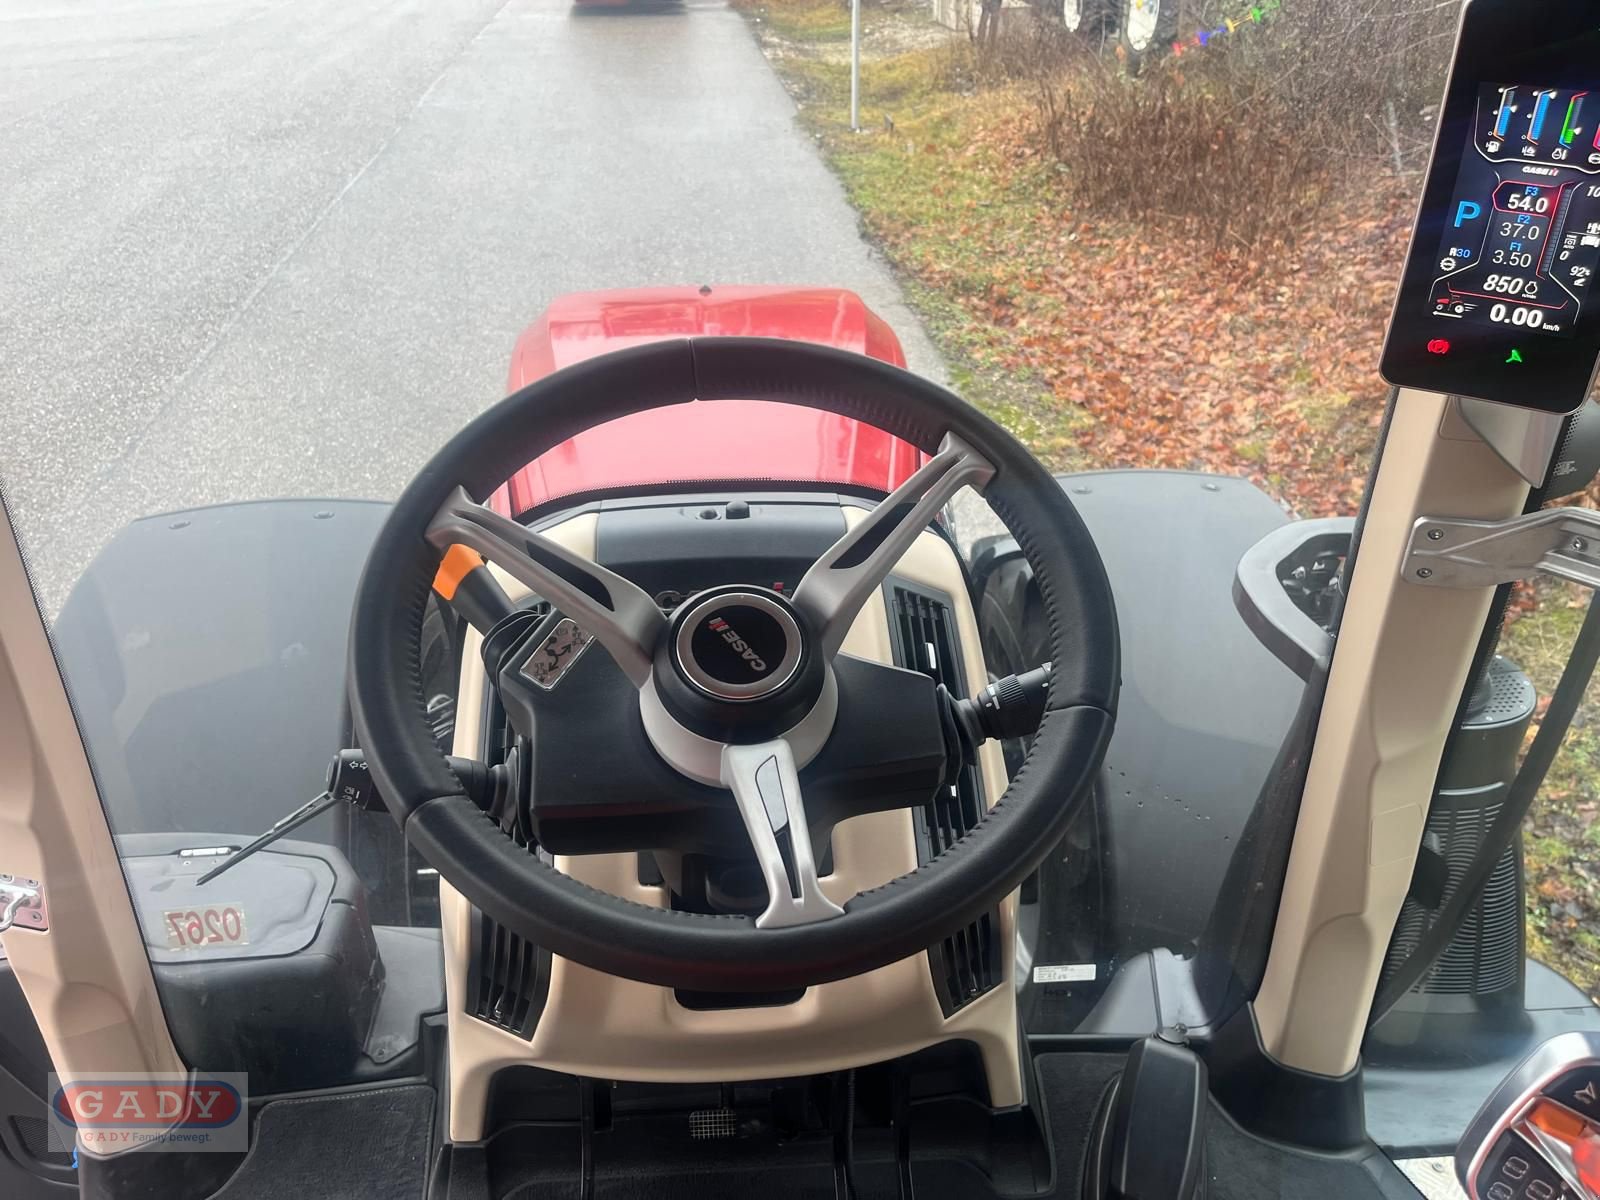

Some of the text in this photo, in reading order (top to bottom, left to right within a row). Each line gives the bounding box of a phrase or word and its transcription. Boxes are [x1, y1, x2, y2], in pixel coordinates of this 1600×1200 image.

[1525, 186, 1539, 196] F3
[1507, 193, 1548, 213] 54.0
[1454, 200, 1481, 228] P
[1517, 214, 1530, 224] F2
[1500, 222, 1540, 240] 37.0
[1509, 242, 1522, 252] F1
[1559, 250, 1570, 261] 0
[1492, 249, 1532, 268] 3.50
[1483, 274, 1523, 295] 850
[1489, 304, 1543, 328] 0.00
[721, 630, 767, 671] CASE
